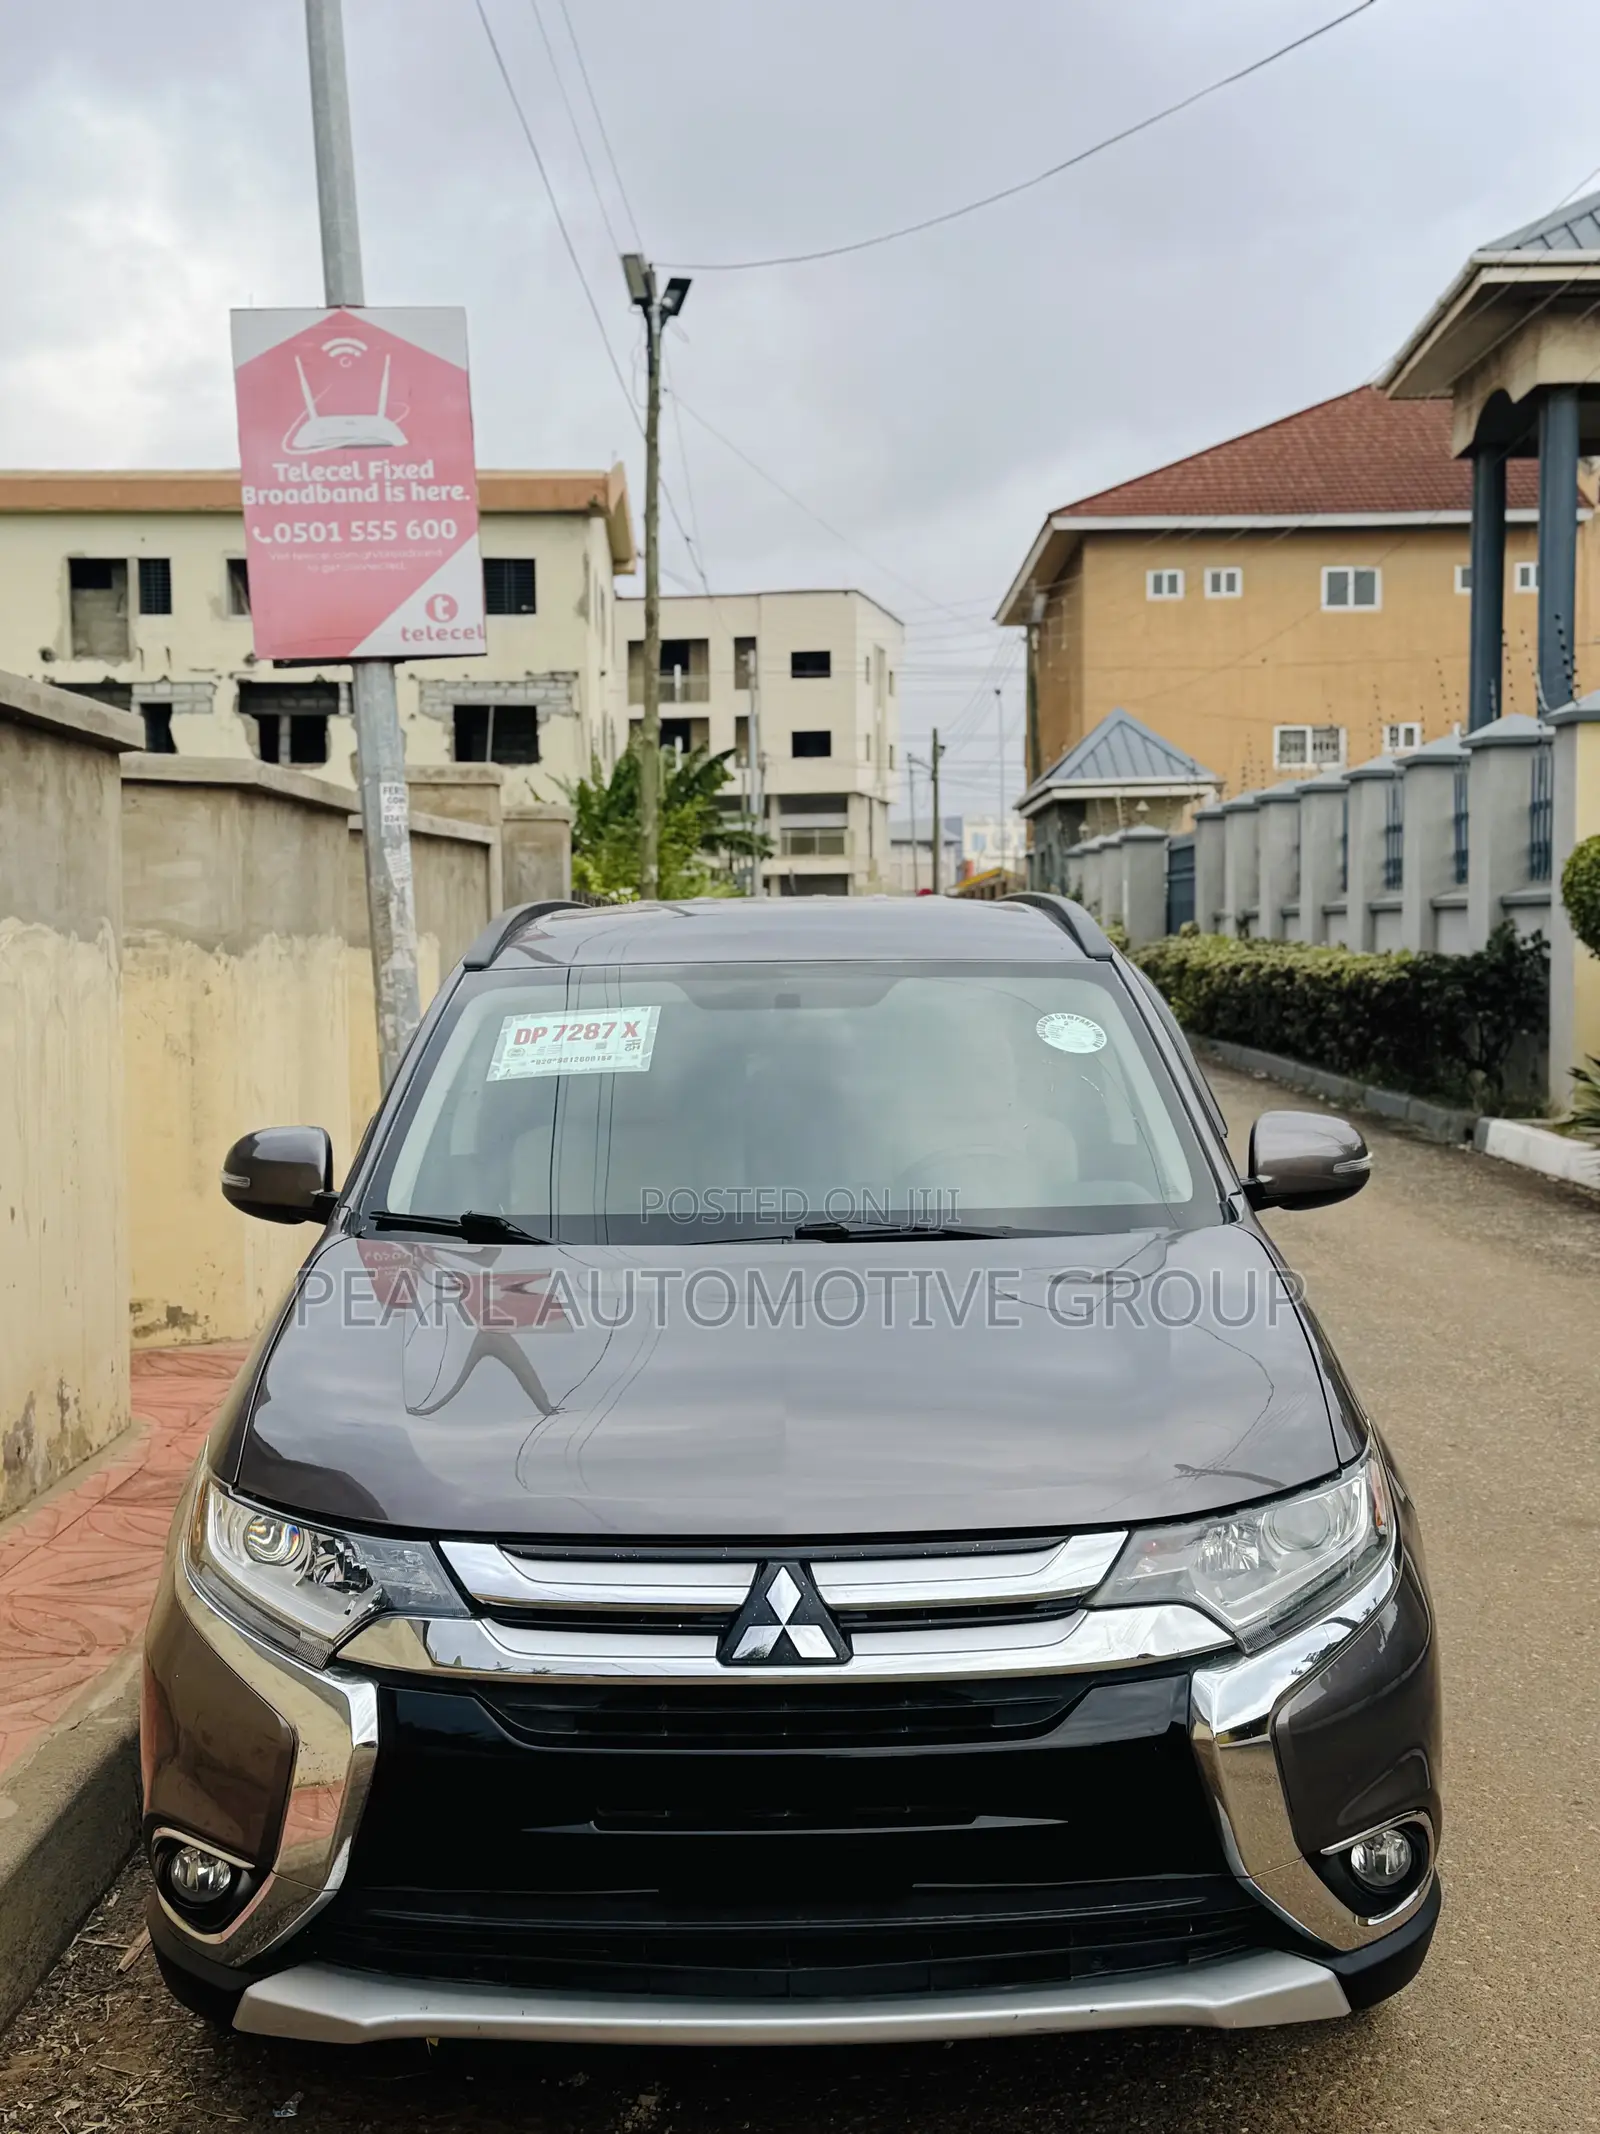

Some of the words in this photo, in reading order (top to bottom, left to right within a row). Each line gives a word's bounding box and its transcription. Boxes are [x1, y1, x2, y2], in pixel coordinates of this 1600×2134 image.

[272, 461, 364, 483] Telecel
[369, 459, 435, 480] Fixed
[241, 483, 379, 506] Broadband
[384, 482, 405, 502] is
[411, 483, 471, 501] here.
[273, 521, 343, 543] 0501
[350, 520, 398, 542] 555
[406, 518, 457, 540] 600
[401, 624, 487, 642] telecel
[514, 1026, 548, 1045] DP
[552, 1022, 617, 1042] 7287
[621, 1020, 641, 1038] X
